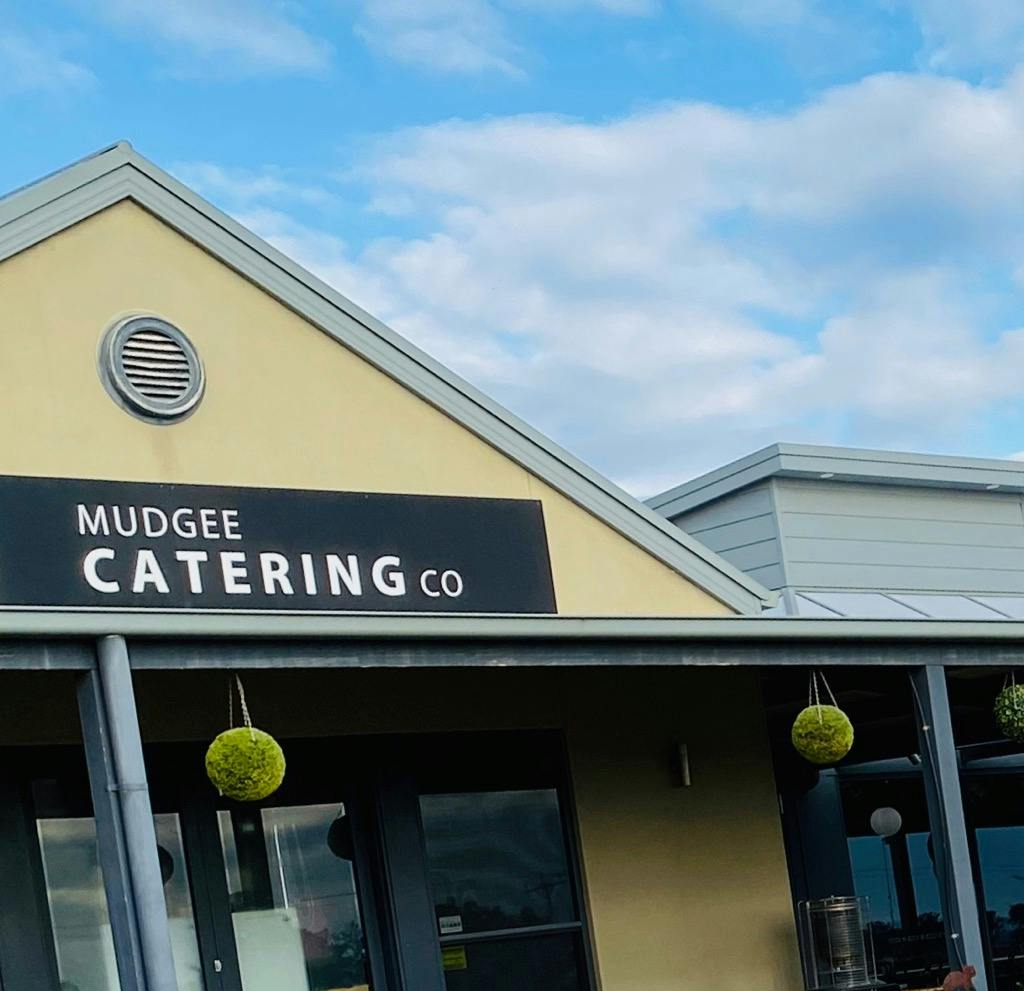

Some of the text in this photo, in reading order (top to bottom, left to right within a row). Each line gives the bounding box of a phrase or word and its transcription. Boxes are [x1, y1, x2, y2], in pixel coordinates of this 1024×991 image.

[77, 504, 242, 540] MUDGEE
[82, 547, 464, 598] CATERING CO
